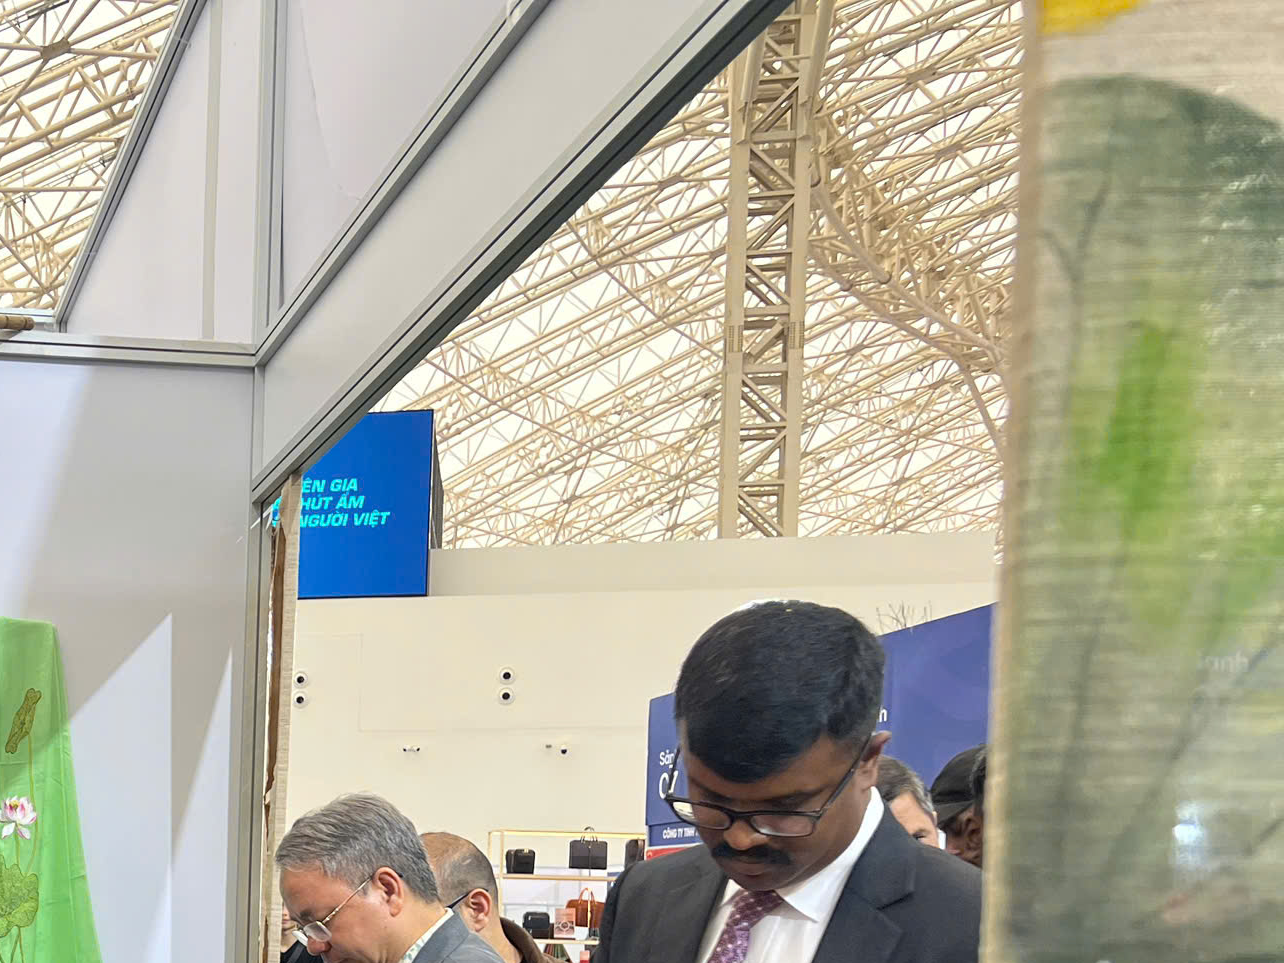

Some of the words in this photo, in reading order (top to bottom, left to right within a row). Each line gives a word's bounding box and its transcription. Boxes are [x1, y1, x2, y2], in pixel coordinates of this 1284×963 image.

[302, 477, 326, 493] ÊN
[330, 478, 358, 492] GIA
[301, 494, 333, 510] HÚT
[300, 510, 349, 528] NGƯỜI
[353, 509, 391, 528] VIỆT
